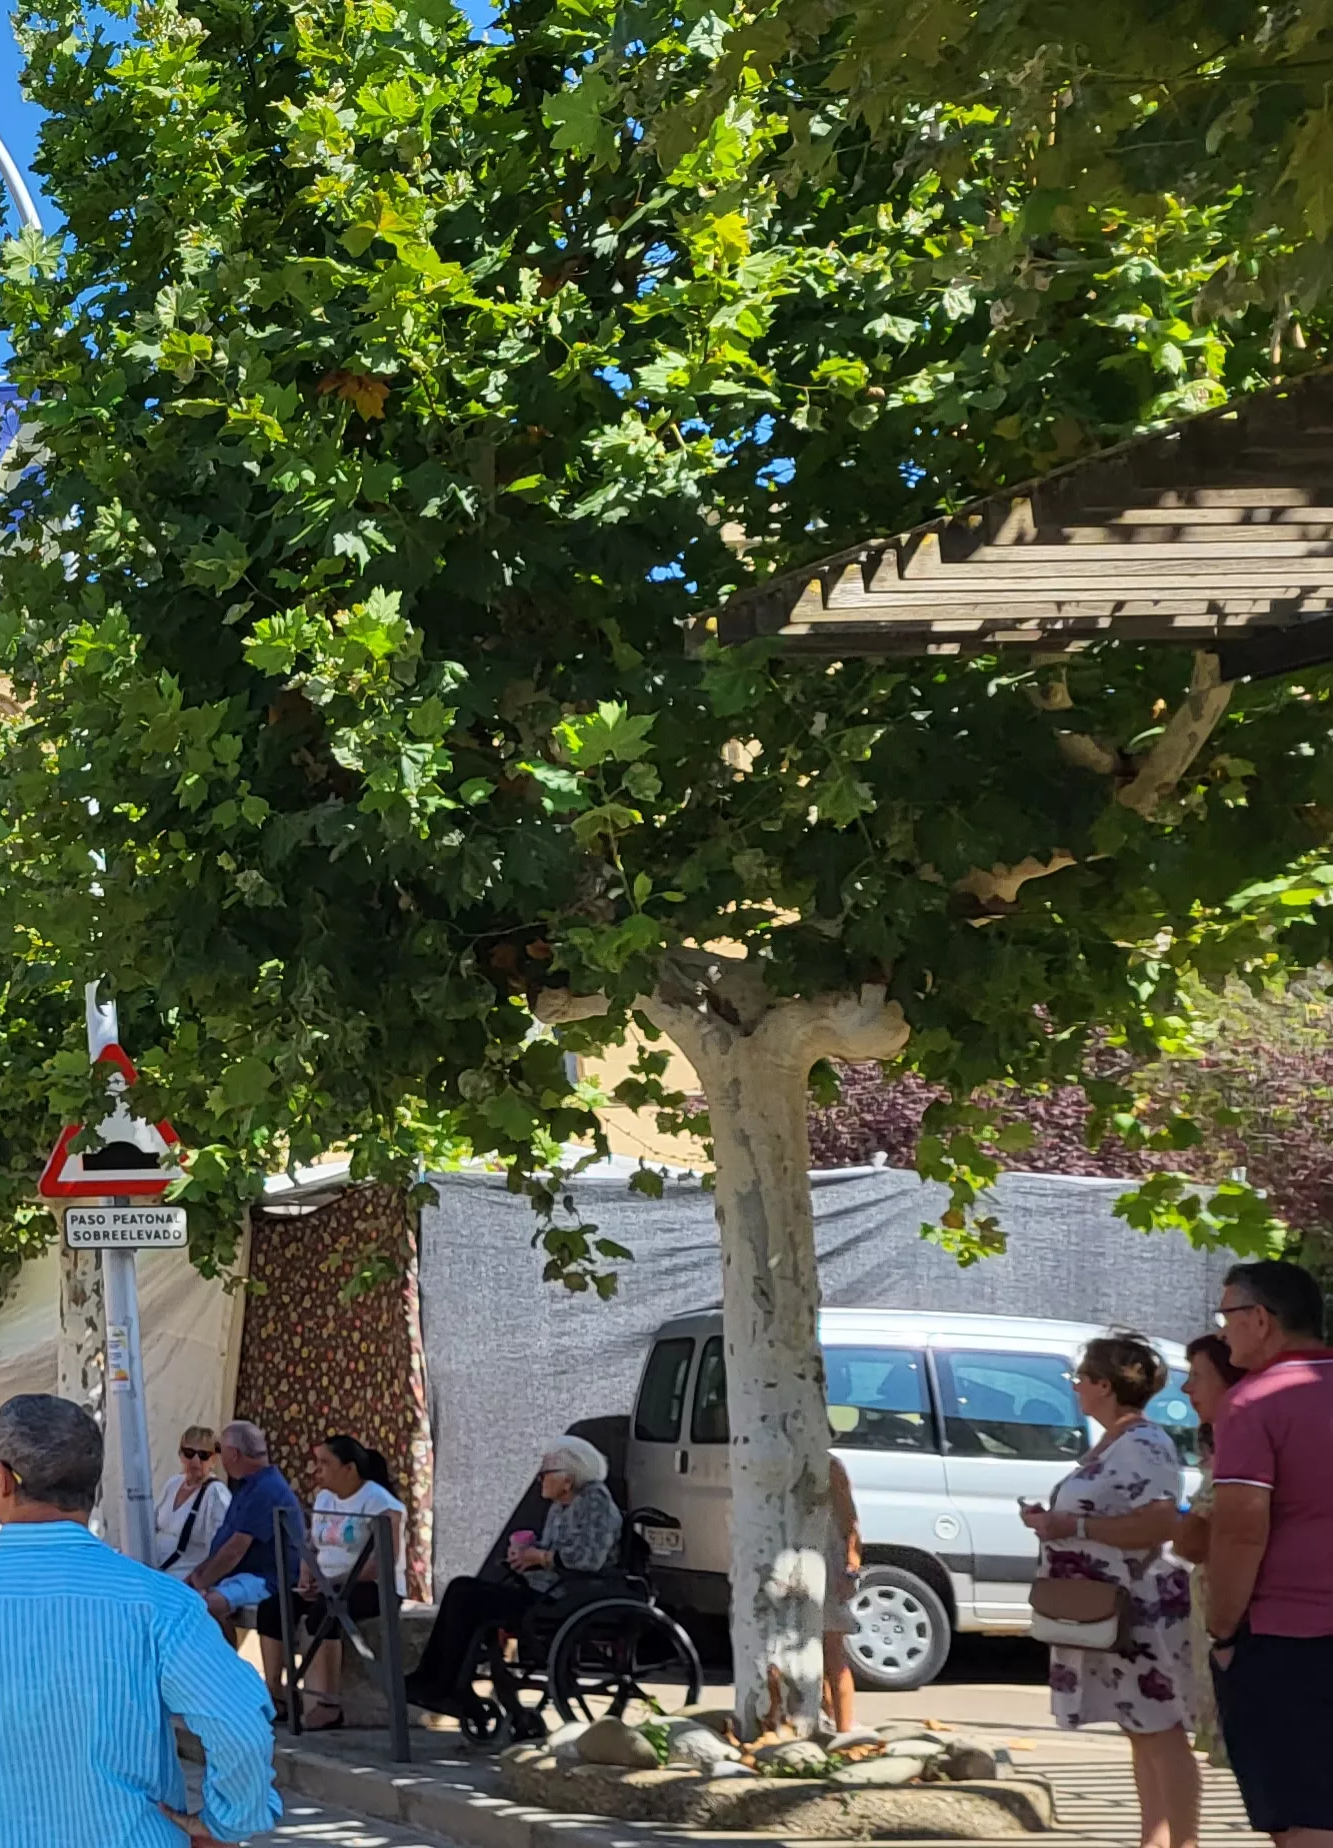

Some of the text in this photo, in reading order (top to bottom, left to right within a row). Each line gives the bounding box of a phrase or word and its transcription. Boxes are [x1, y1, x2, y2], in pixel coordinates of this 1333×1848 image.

[70, 1213, 181, 1225] PASO PEATONAL
[73, 1230, 181, 1241] SOBREELEVADO
